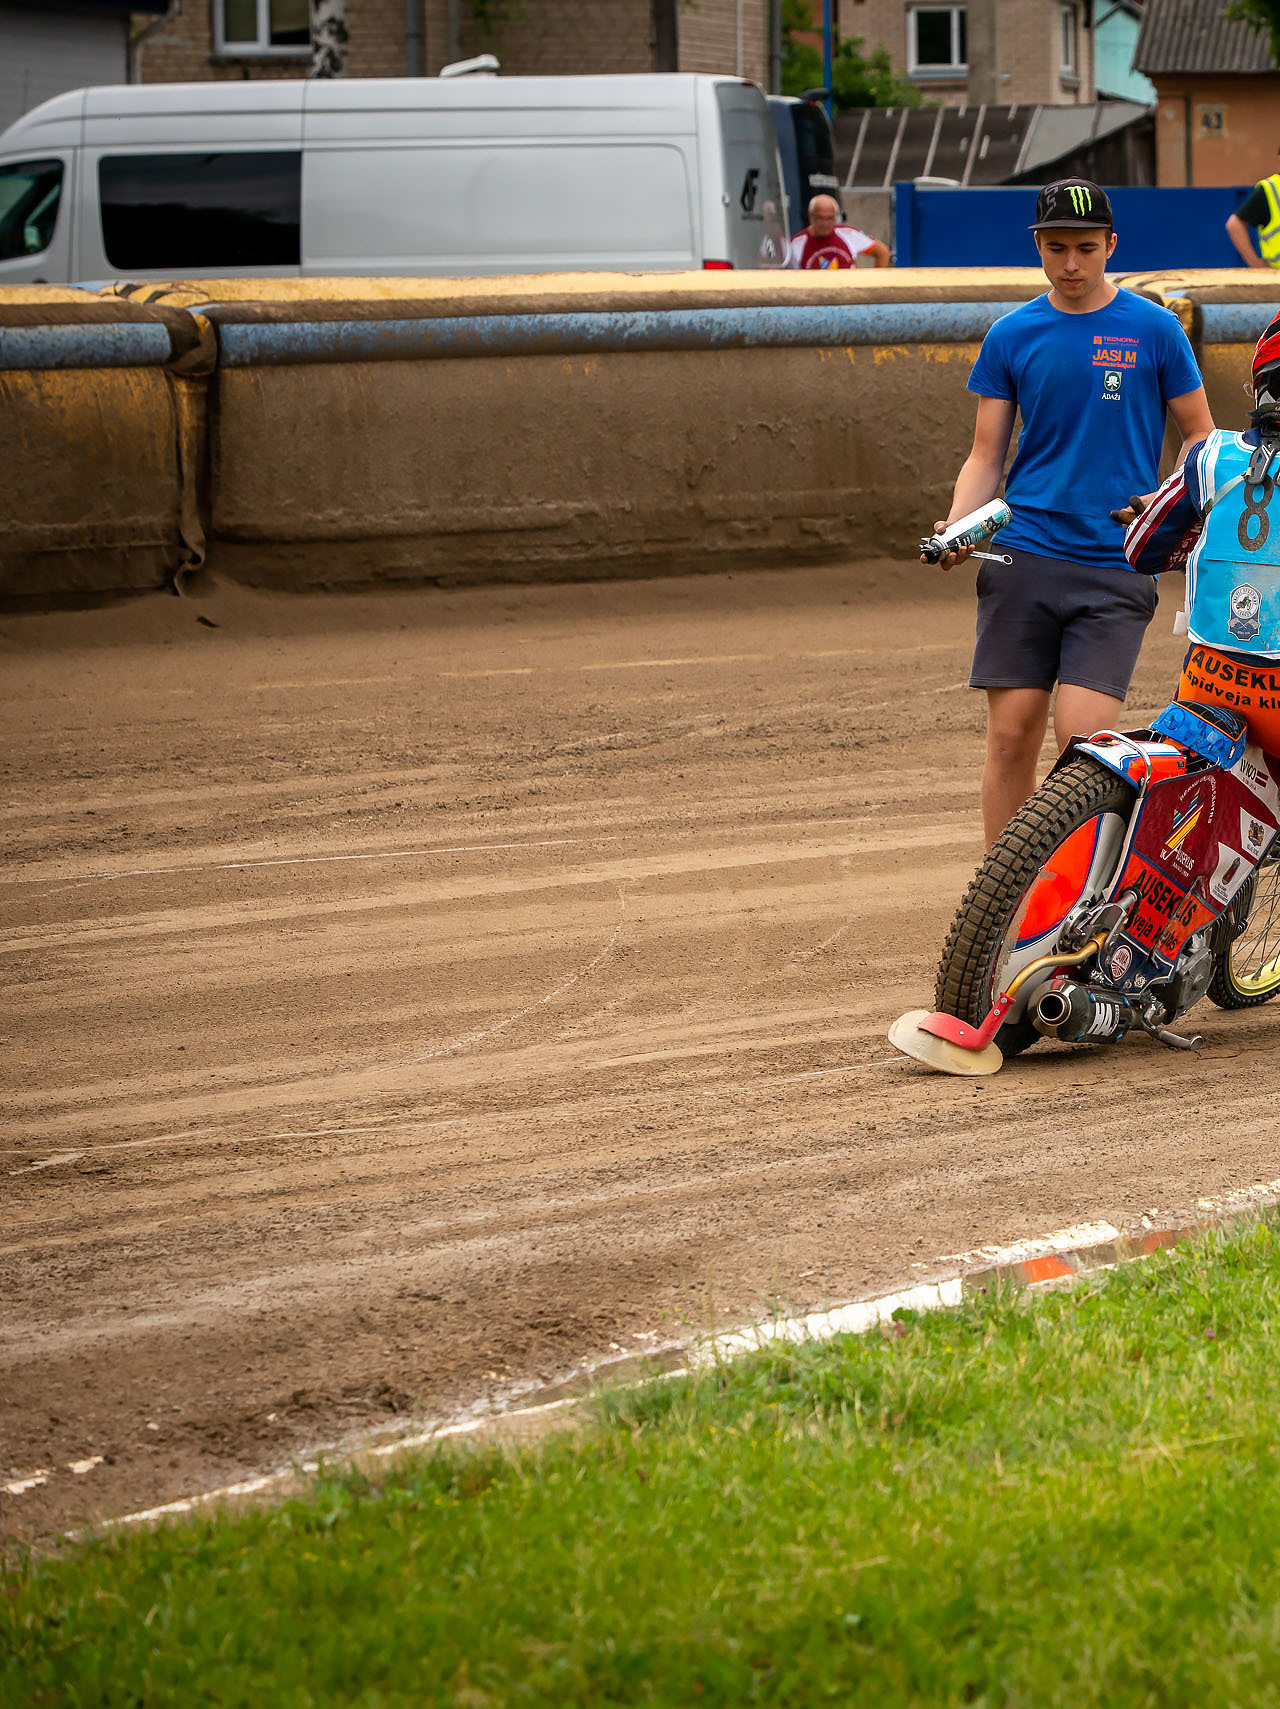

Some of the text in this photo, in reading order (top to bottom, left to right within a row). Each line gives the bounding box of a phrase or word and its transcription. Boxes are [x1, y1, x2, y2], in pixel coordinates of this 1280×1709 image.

[1092, 349, 1137, 363] JASI M
[1238, 475, 1274, 552] 8
[1187, 670, 1251, 706] spīdveja
[1133, 868, 1198, 927] AUSEKIS
